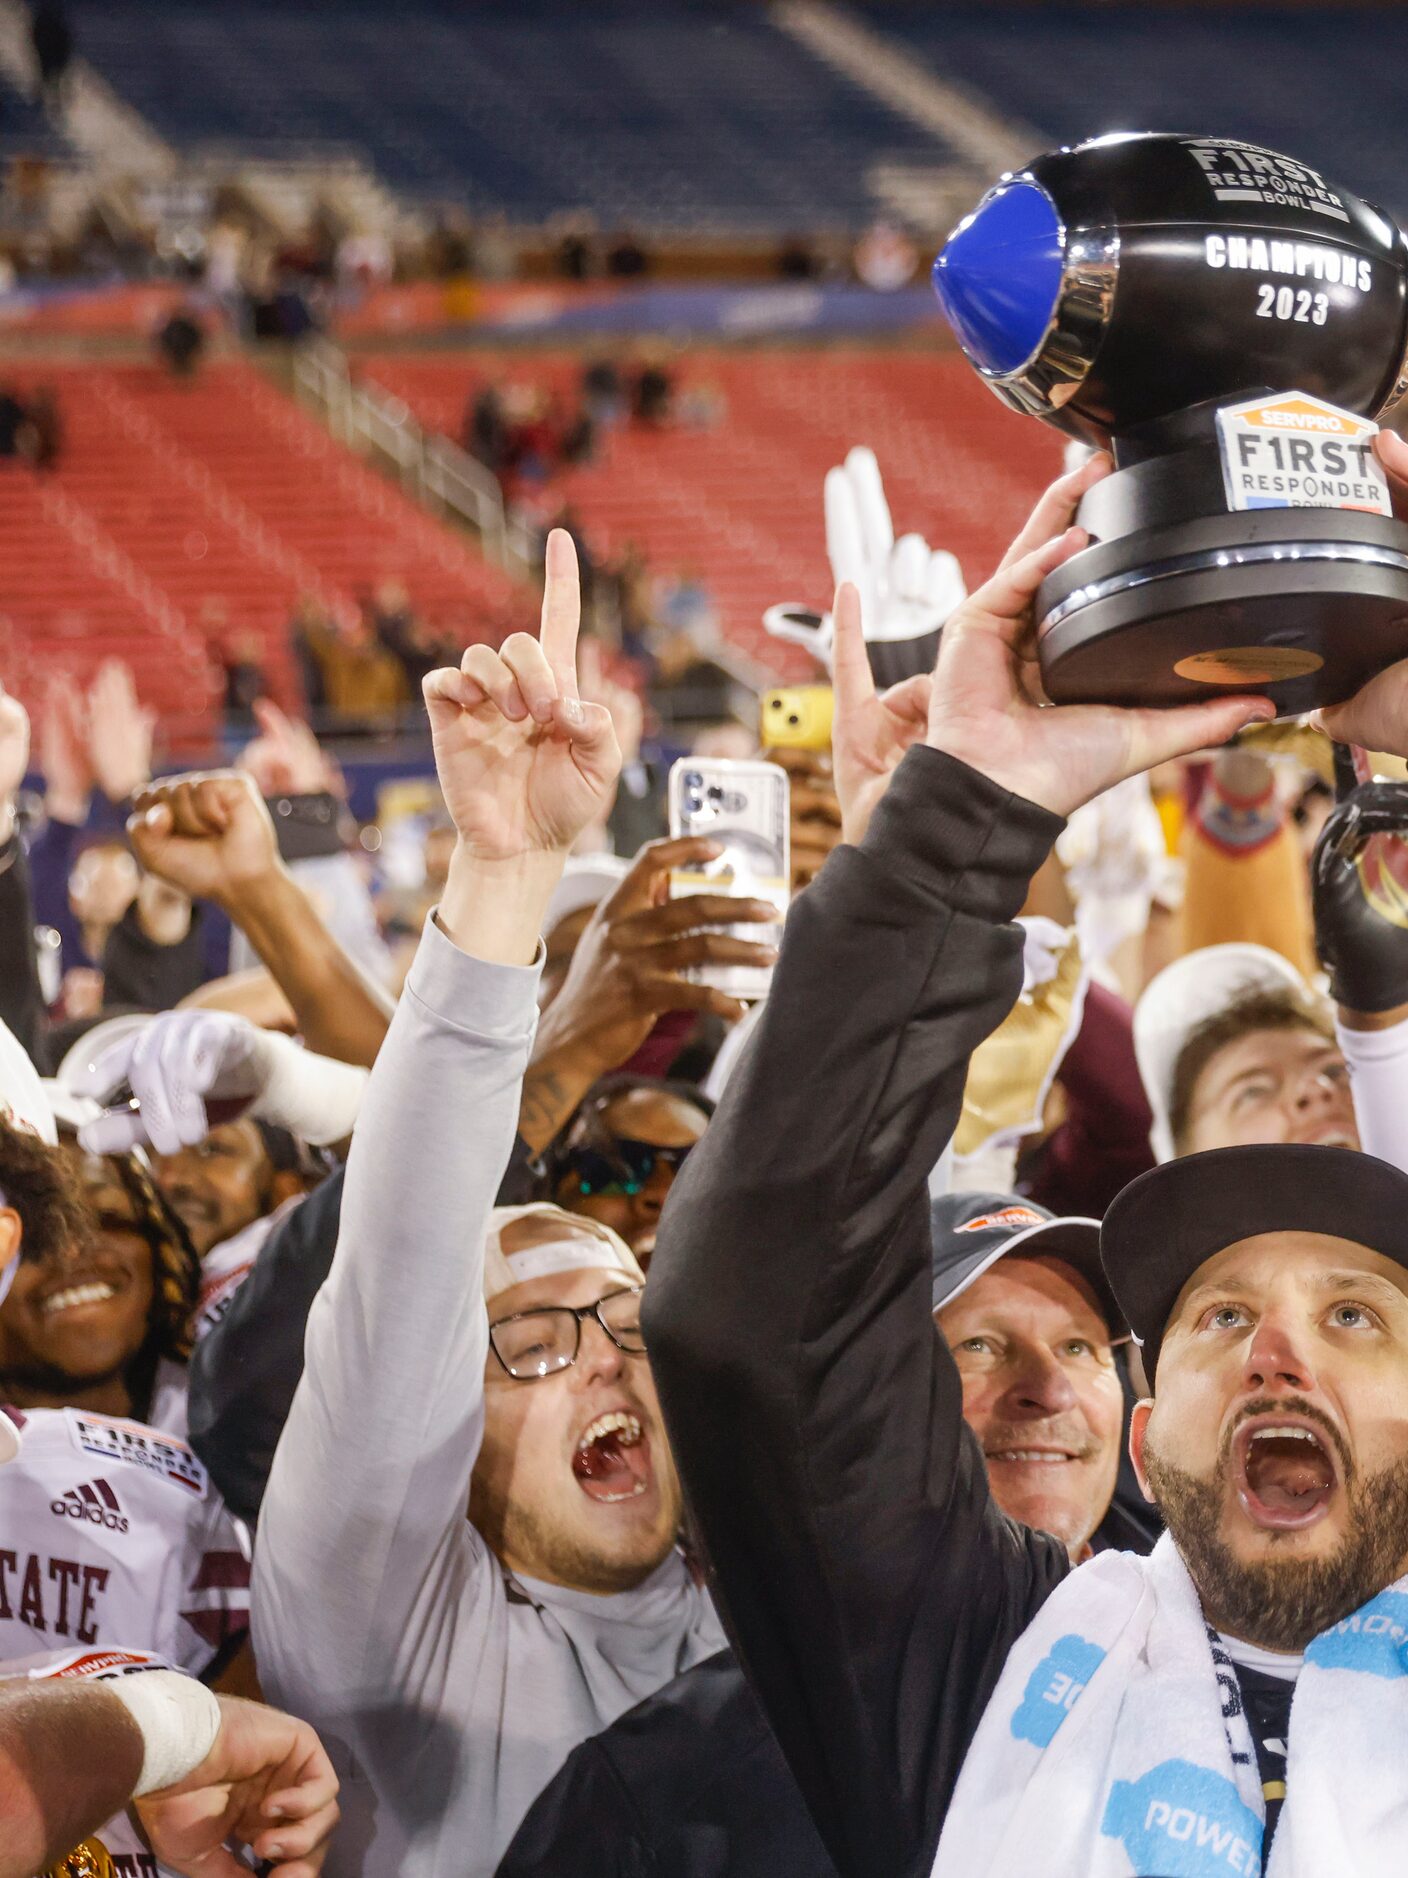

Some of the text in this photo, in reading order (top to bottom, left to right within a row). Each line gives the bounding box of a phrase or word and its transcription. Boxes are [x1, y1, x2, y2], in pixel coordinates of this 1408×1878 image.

[1188, 149, 1327, 189] F1RST
[1205, 173, 1344, 208] RESPONDER
[1262, 192, 1311, 210] BOWL
[1205, 234, 1372, 292] CHAMPIONS
[1256, 284, 1329, 326] 2023
[1237, 433, 1373, 478] F1RST
[1242, 474, 1381, 500] RESPONDER
[50, 1499, 129, 1534] adidas
